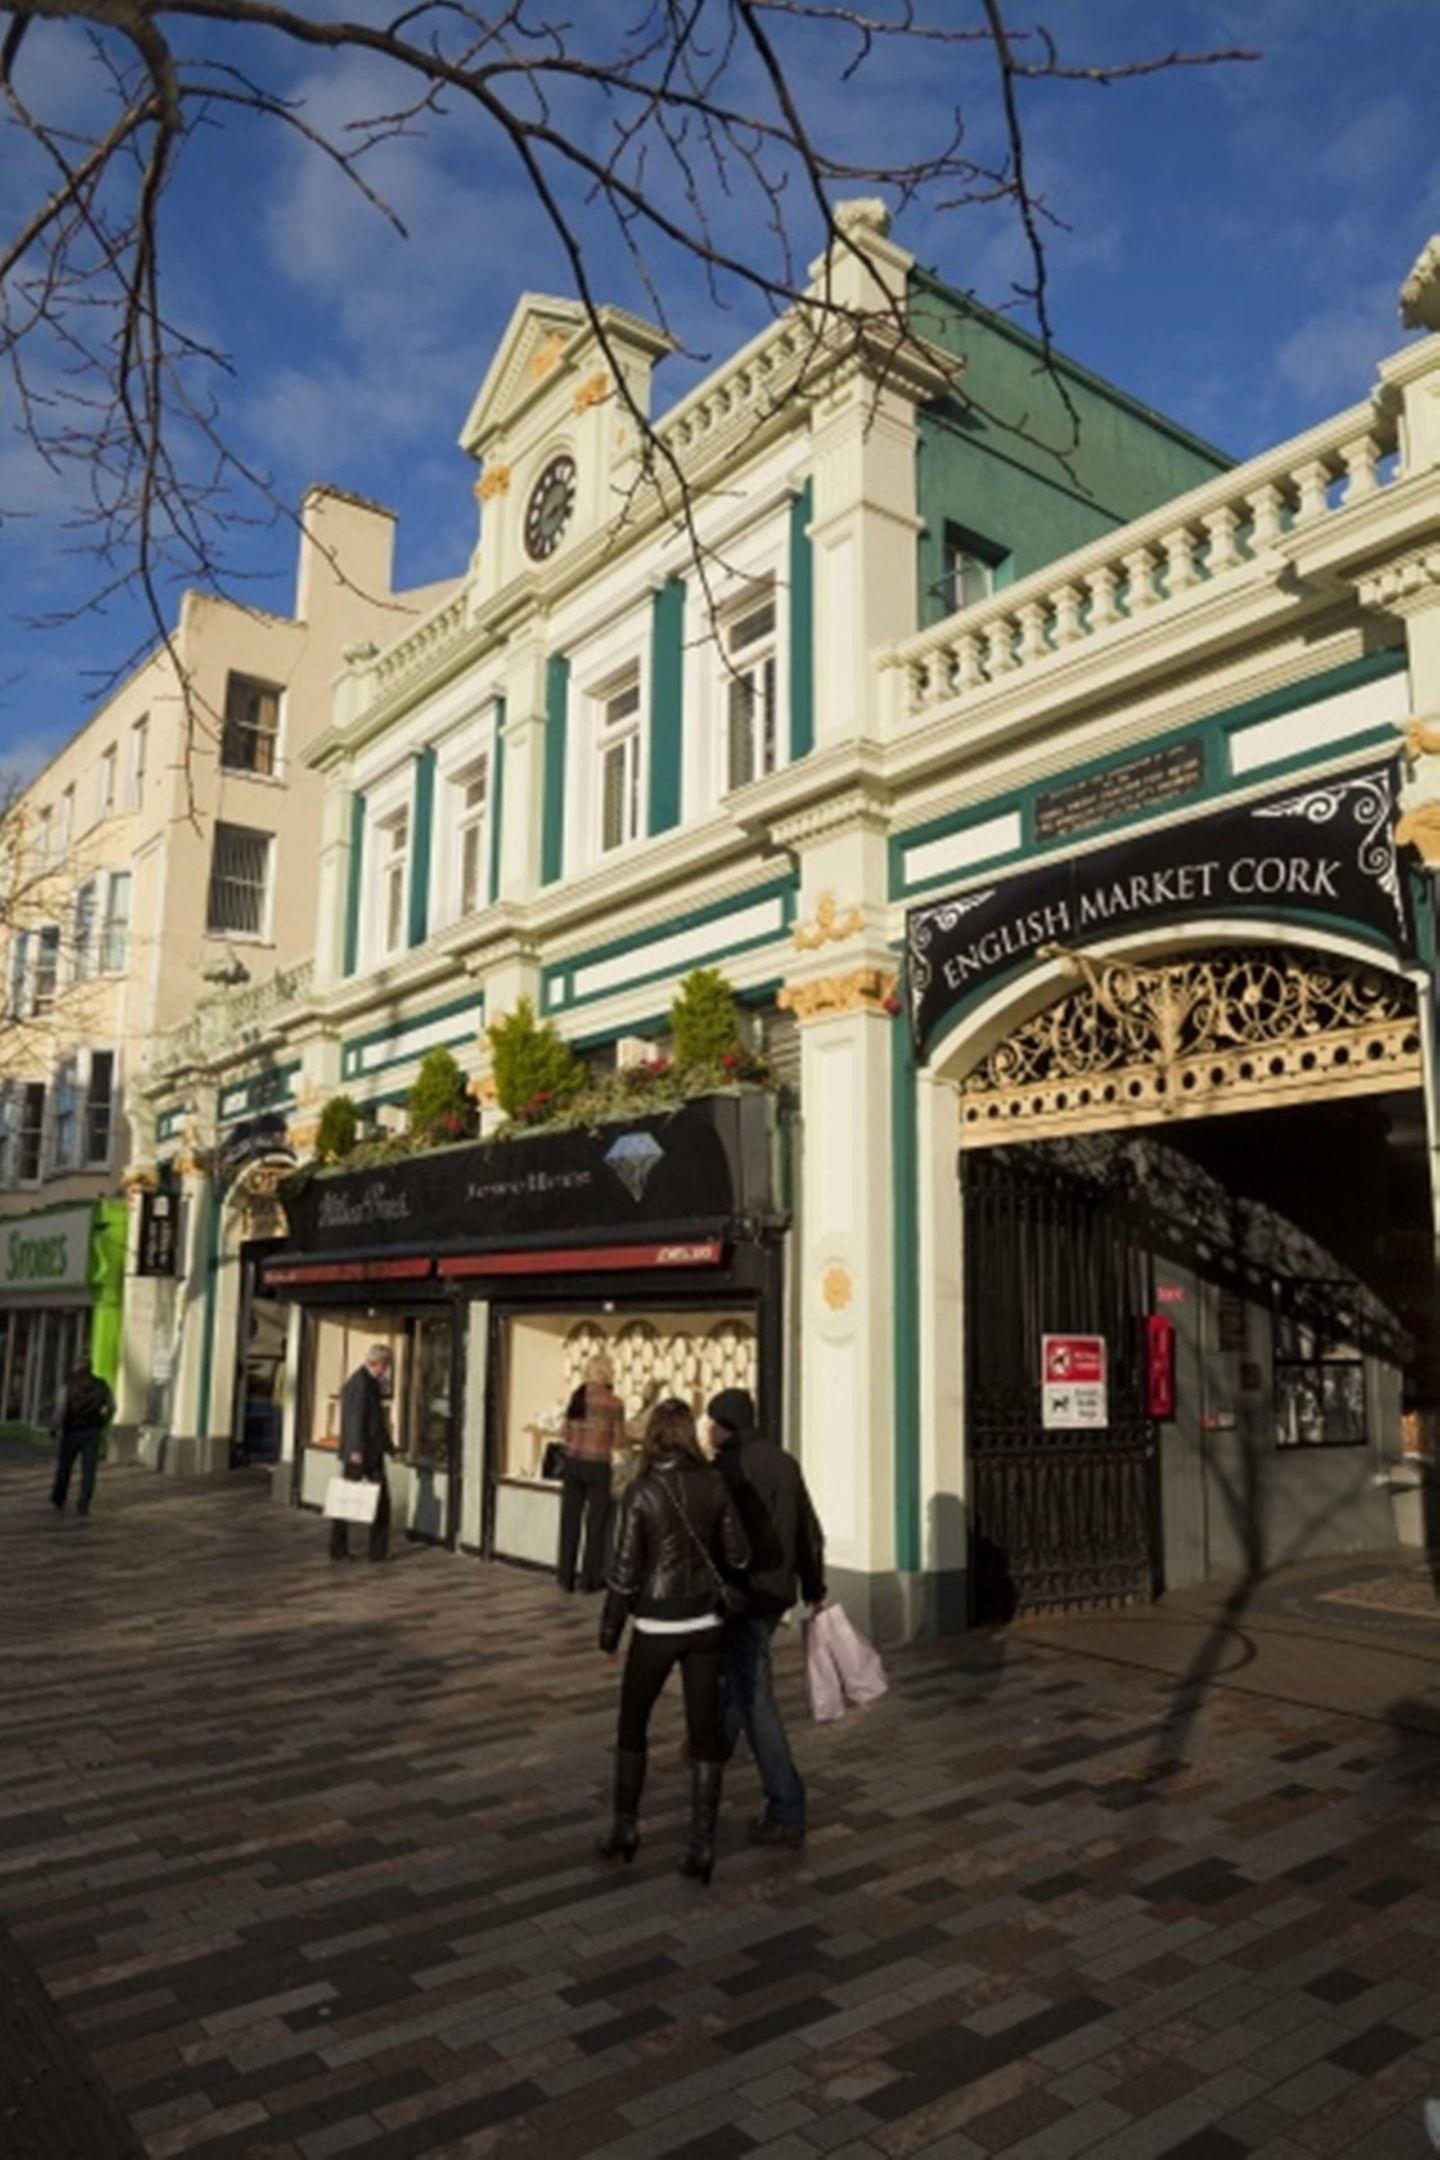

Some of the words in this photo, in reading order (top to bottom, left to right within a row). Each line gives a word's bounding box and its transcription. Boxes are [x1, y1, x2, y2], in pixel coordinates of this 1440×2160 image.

[943, 901, 1070, 989] ENGLISH
[1080, 862, 1220, 925] MARKET
[1228, 857, 1342, 898] CORK
